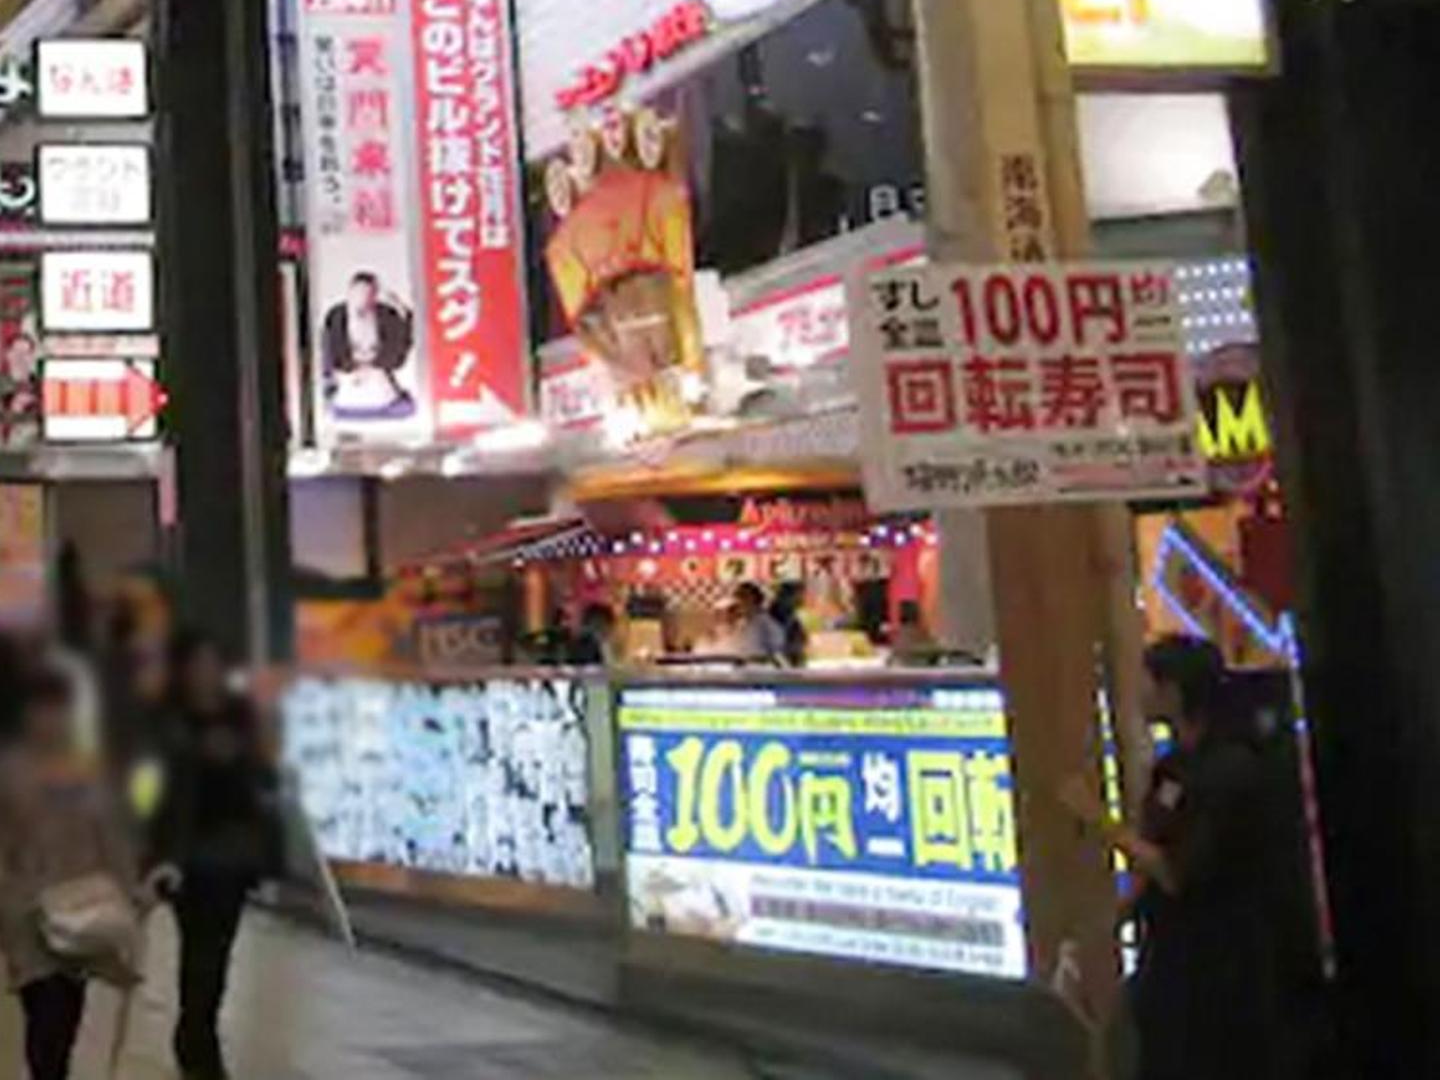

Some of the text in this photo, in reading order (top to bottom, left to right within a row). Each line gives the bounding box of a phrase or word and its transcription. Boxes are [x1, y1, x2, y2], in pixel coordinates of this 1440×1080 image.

[60, 268, 136, 314] 近道
[950, 272, 1128, 348] 100円
[884, 352, 1182, 436] 回転寿司
[665, 736, 858, 866] 100円
